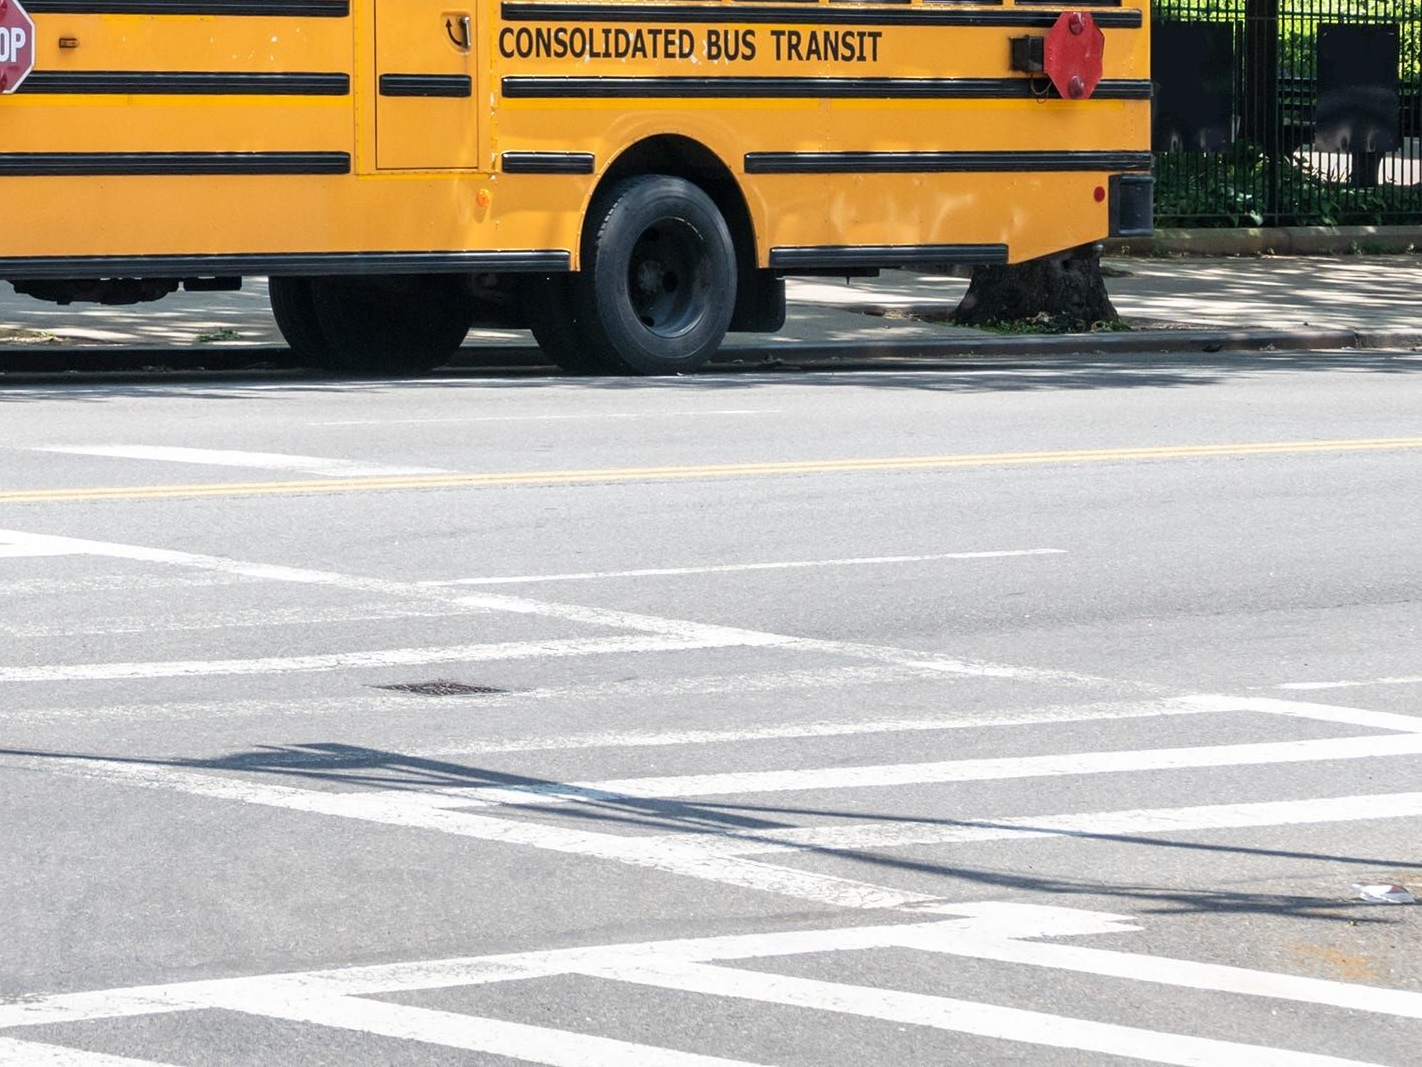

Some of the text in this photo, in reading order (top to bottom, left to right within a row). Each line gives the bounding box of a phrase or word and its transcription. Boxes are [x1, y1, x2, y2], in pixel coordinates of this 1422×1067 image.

[498, 27, 882, 62] CONSOLIDATED BUS TRANSIT
